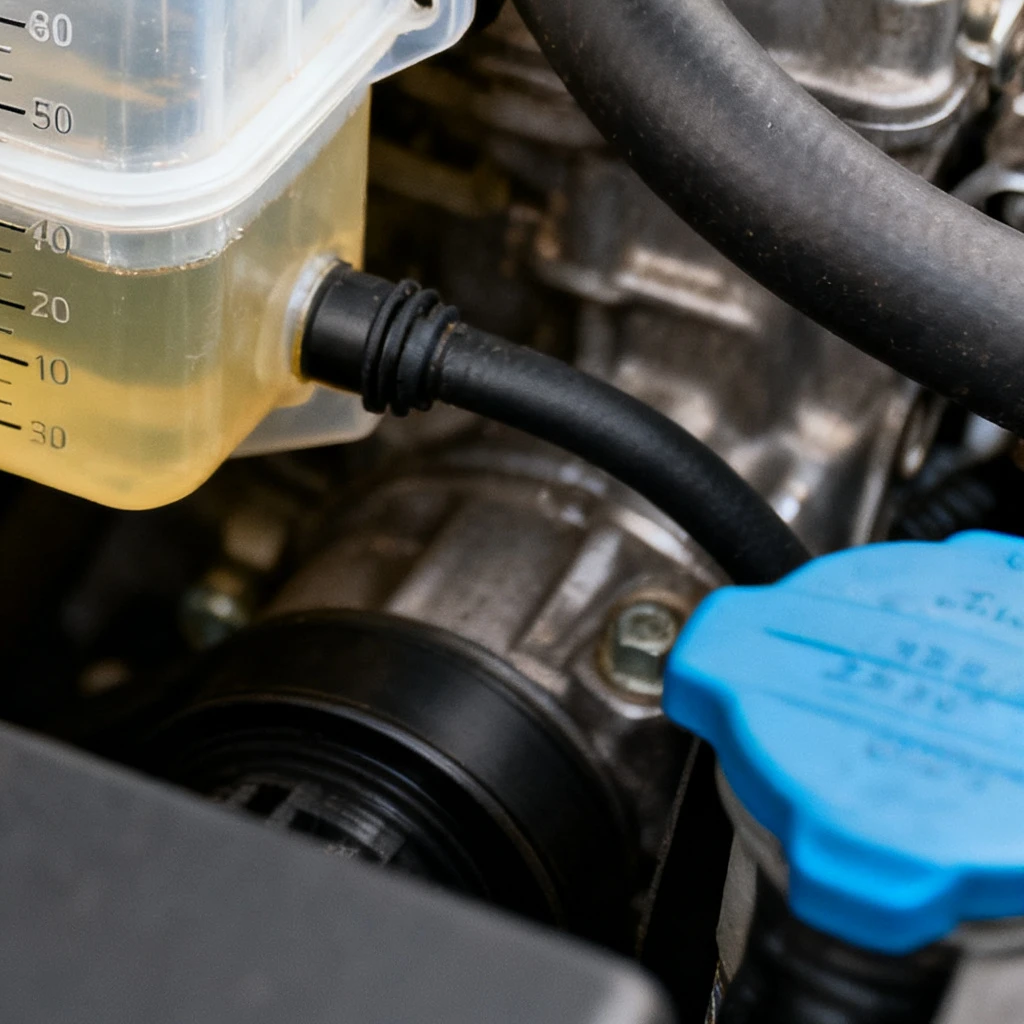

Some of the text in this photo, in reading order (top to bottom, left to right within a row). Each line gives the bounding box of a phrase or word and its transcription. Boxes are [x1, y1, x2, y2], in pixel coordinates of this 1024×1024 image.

[32, 98, 73, 134] 50
[26, 219, 73, 254] 40
[31, 291, 70, 323] 20
[36, 355, 69, 385] 10
[30, 420, 67, 449] 30
